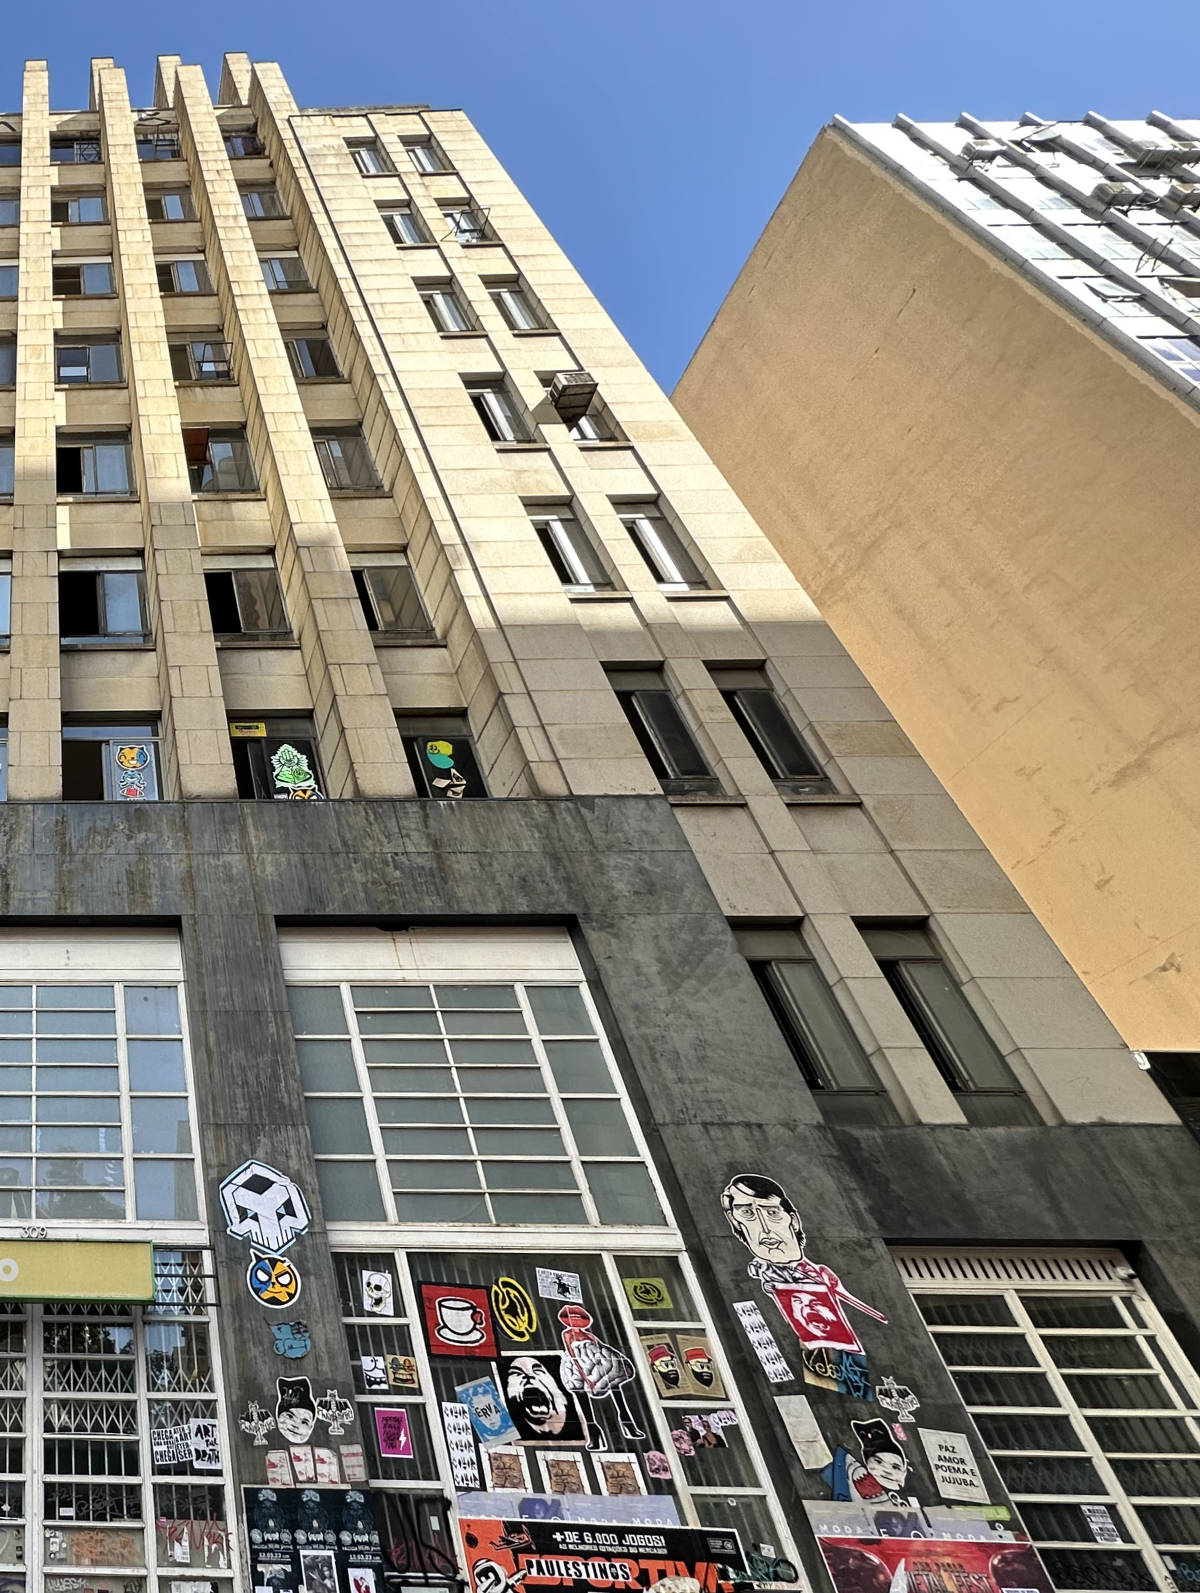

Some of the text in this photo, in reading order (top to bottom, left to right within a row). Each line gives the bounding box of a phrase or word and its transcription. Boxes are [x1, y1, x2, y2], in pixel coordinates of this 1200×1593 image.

[21, 1224, 48, 1239] 309
[474, 1403, 501, 1418] ERVA
[194, 1424, 217, 1440] ART
[937, 1444, 956, 1454] PAZ
[936, 1454, 967, 1466] AMOR
[934, 1463, 977, 1477] POEMA E
[818, 1525, 865, 1534] MODA
[583, 1531, 619, 1545] 6.000
[622, 1533, 666, 1547] JOGOS!
[525, 1559, 631, 1581] PAULESTINOS
